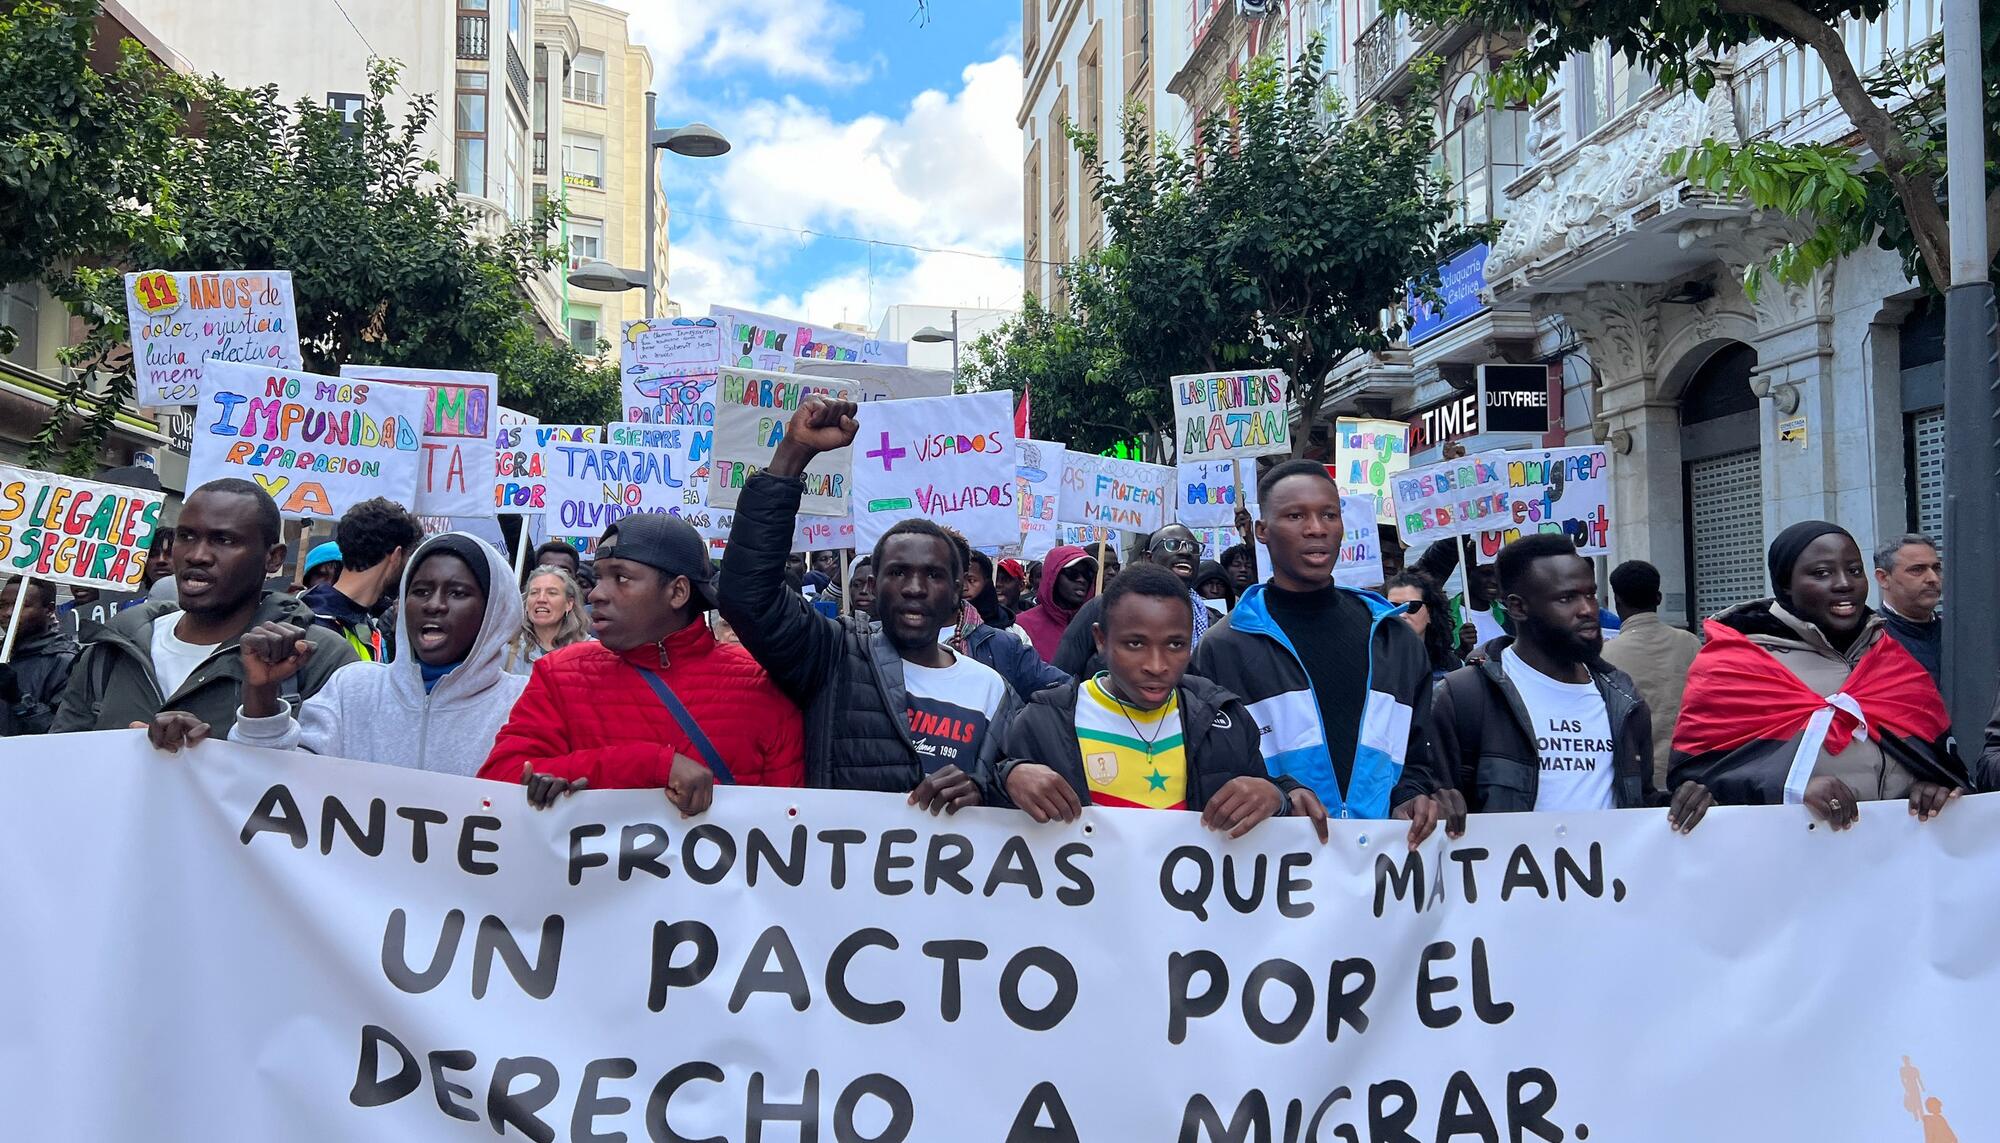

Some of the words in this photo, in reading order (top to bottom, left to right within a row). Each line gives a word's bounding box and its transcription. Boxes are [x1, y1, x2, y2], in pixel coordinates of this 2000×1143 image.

[140, 275, 177, 309] 11
[189, 273, 252, 309] AÑOS
[259, 277, 281, 306] de
[142, 315, 199, 342] dolor,
[203, 307, 286, 345] injusticia
[146, 343, 188, 365] lucha
[265, 377, 300, 398] NO
[315, 381, 369, 404] MAS
[660, 386, 700, 405] NO
[1180, 378, 1206, 407] LAS
[1206, 374, 1281, 412] FRONTERAS
[210, 391, 418, 450] IMPUNIDAD
[1183, 410, 1289, 455] MATAN
[225, 441, 380, 477] REPARACION
[556, 446, 683, 488] TARAJAL
[1198, 463, 1208, 480] y
[1350, 460, 1386, 486] NO
[253, 474, 333, 515] YA
[603, 483, 642, 507] NO
[1399, 475, 1435, 502] PAS
[1512, 487, 1554, 525] est
[28, 485, 163, 549] LEGALES
[1084, 501, 1143, 527] MATAN
[1404, 507, 1435, 534] PAS
[12, 528, 148, 584] SEGURAS
[1549, 719, 1582, 733] LAS
[940, 745, 958, 759] 1990
[1536, 737, 1614, 752] ONTERAS
[1538, 757, 1596, 772] MATAN
[240, 784, 502, 876] ANTE
[568, 823, 1095, 906] FRONTERAS
[1159, 844, 1316, 922] QUE
[381, 908, 564, 1000] UN
[647, 919, 1078, 1032] PACTO
[1168, 949, 1377, 1045] POR
[1416, 937, 1515, 1029] EL
[349, 1024, 913, 1143] DERECHO
[1004, 1081, 1081, 1143] A
